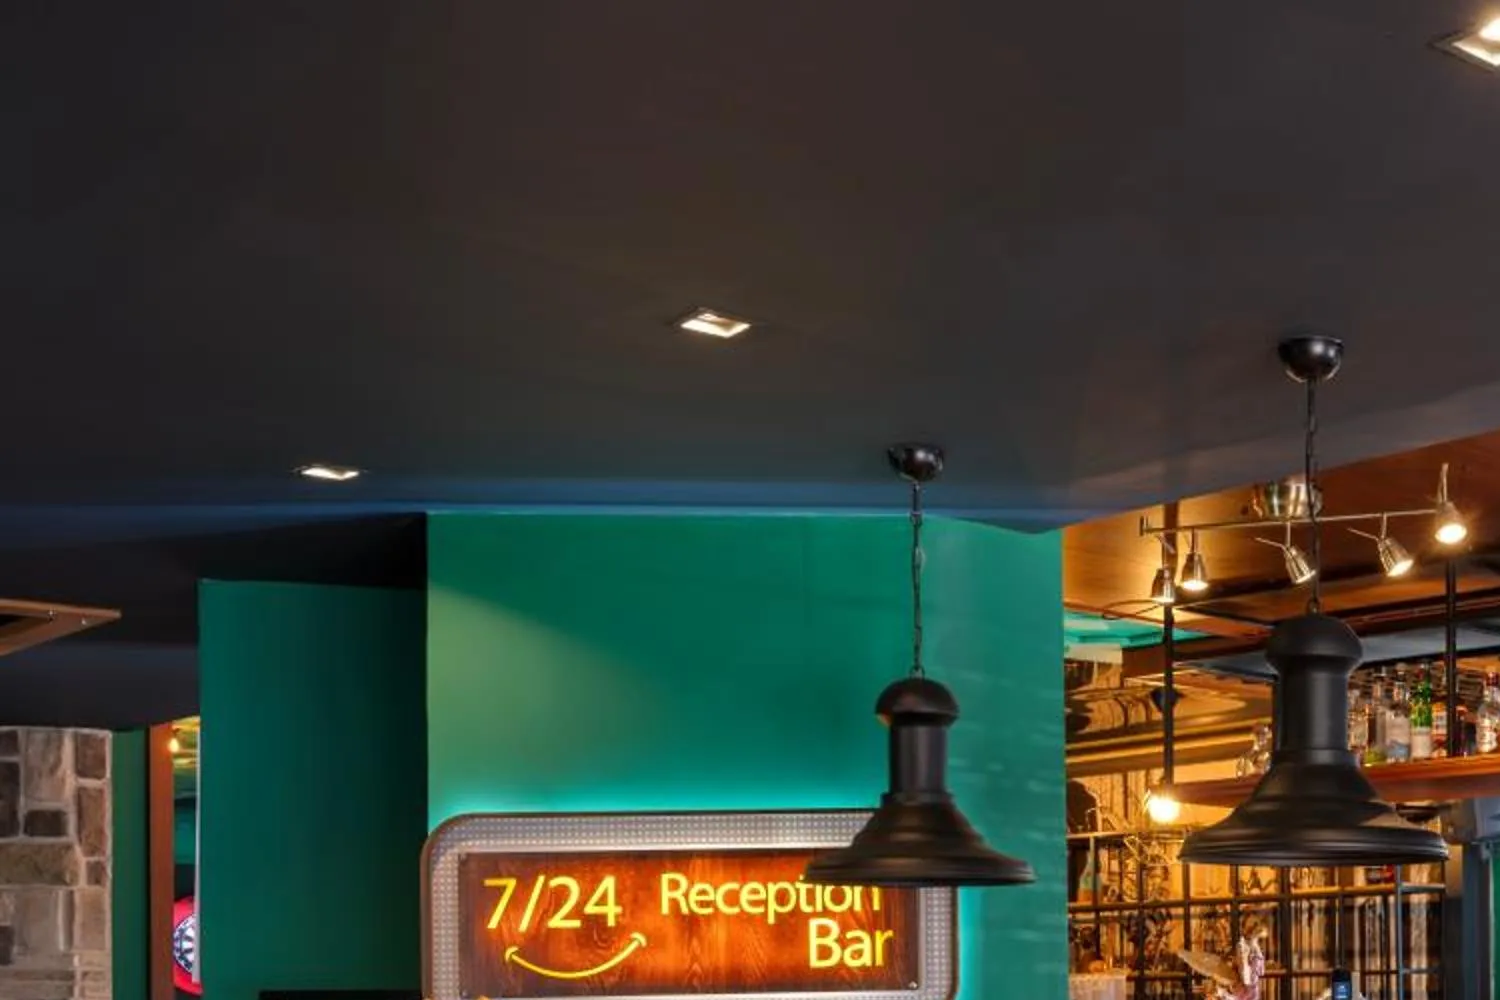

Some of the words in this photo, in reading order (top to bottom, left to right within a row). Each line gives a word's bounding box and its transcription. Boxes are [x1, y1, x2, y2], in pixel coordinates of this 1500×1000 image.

[483, 872, 623, 933] 7/24
[660, 872, 882, 925] Reception
[808, 917, 894, 968] Bar
